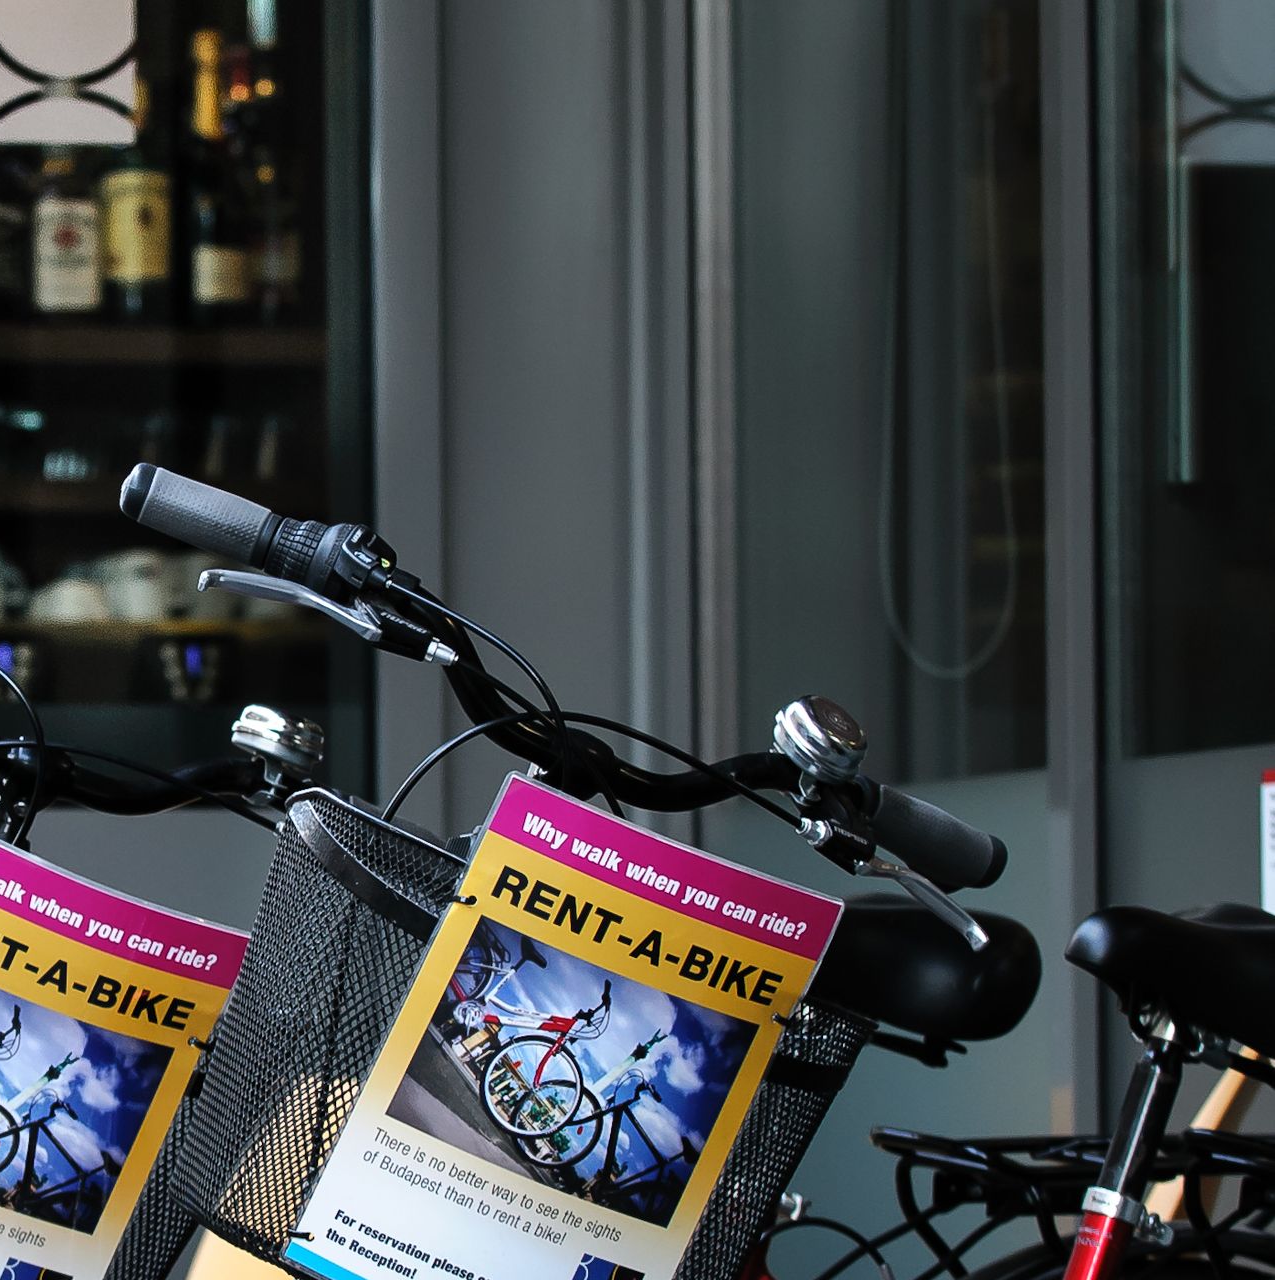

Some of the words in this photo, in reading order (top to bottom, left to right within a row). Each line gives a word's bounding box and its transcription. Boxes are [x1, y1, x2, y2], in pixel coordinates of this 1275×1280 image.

[522, 812, 569, 850] Why
[571, 837, 623, 873] walk
[625, 861, 680, 896] when
[680, 885, 720, 912] you
[721, 900, 757, 925] can
[758, 911, 807, 941] ride?
[29, 894, 84, 928] when
[85, 917, 125, 944] you
[127, 933, 165, 957] can
[166, 945, 218, 971] ride?
[491, 865, 784, 1007] RENT-A-BIKE
[362, 1149, 377, 1163] of
[379, 1155, 442, 1196] Budapest
[444, 1185, 474, 1210] than
[476, 1199, 491, 1216] to
[492, 1208, 521, 1230] rent
[522, 1220, 531, 1233] a
[533, 1221, 567, 1246] bike!
[375, 1127, 411, 1156] There
[413, 1147, 426, 1163] is
[428, 1156, 446, 1173] no
[448, 1162, 490, 1191] better
[491, 1183, 518, 1205] way
[520, 1192, 534, 1210] to
[535, 1201, 560, 1220] see
[562, 1209, 583, 1229] the
[584, 1219, 622, 1243] sights
[8, 1225, 46, 1249] sights
[325, 1227, 347, 1247] the
[348, 1240, 418, 1280] Reception!
[334, 1209, 357, 1228] For
[357, 1222, 431, 1262] reservation
